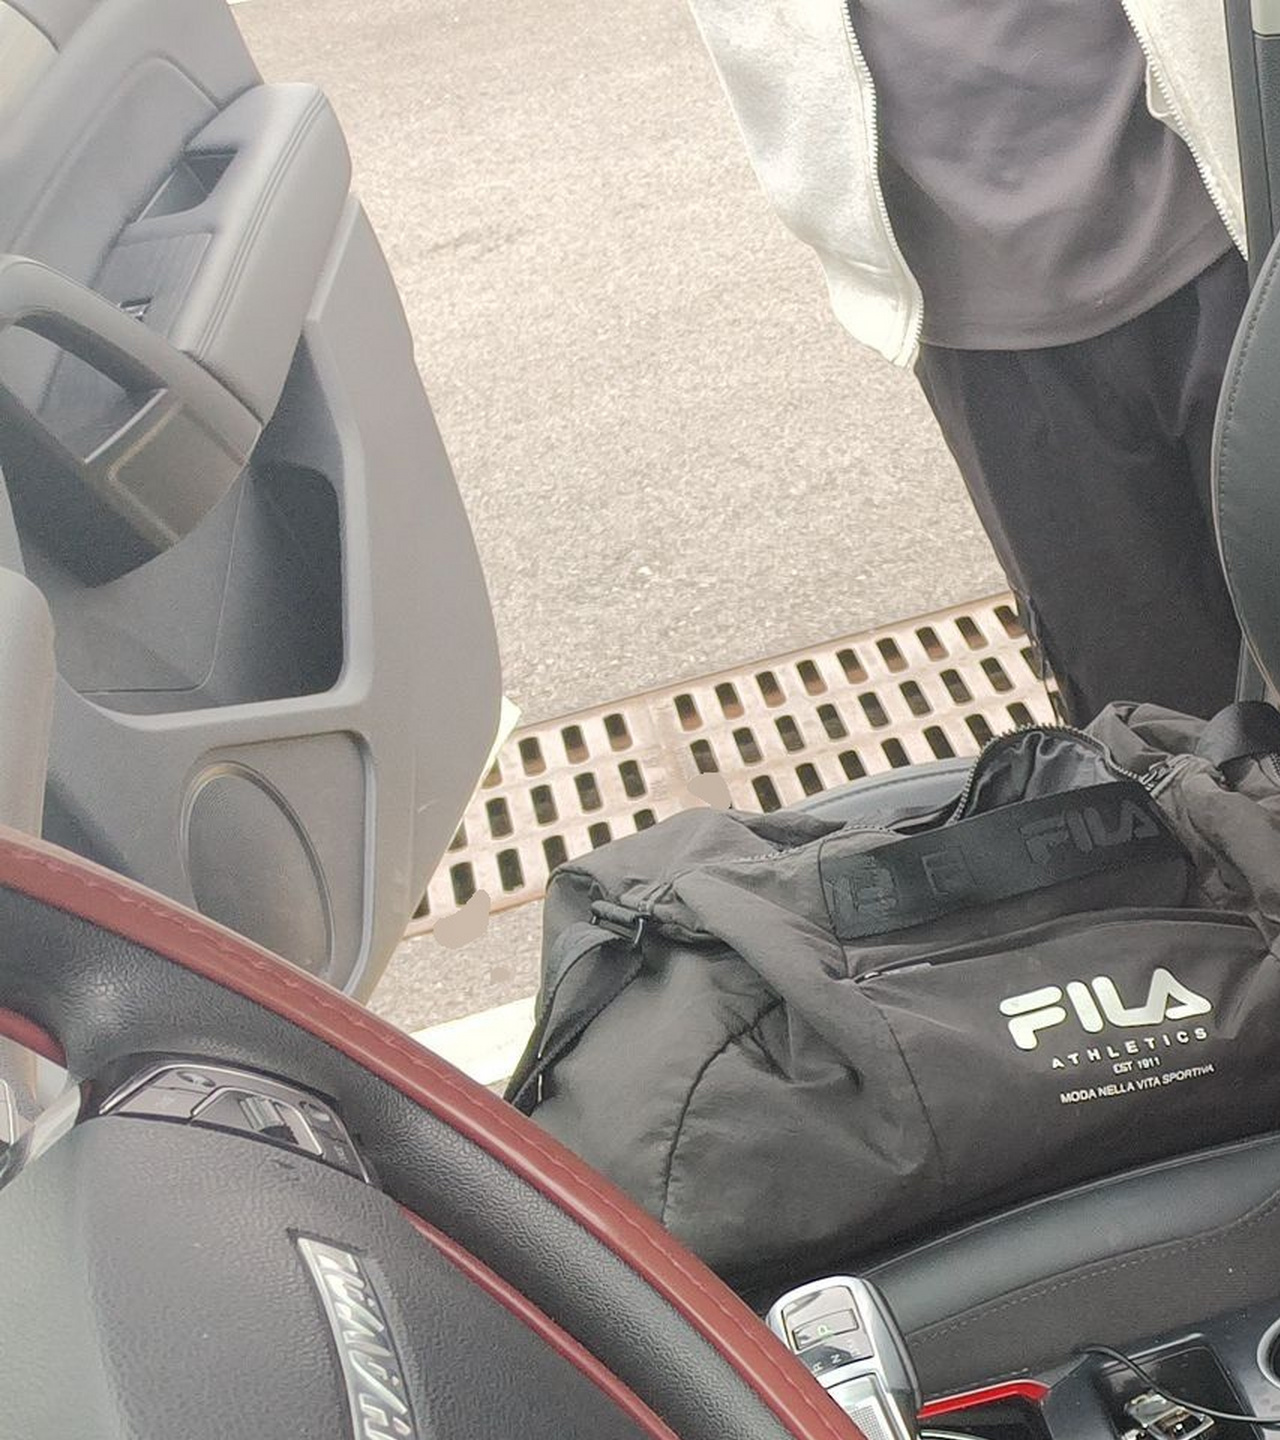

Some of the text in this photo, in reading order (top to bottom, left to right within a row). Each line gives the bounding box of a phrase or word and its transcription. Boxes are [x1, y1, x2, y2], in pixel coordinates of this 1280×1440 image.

[999, 967, 1212, 1050] FILA
[1052, 1027, 1208, 1069] ATHLETICS
[1112, 1056, 1161, 1075] EST 1911
[1059, 1064, 1215, 1104] MODA NELLA VITA SPORTIVA
